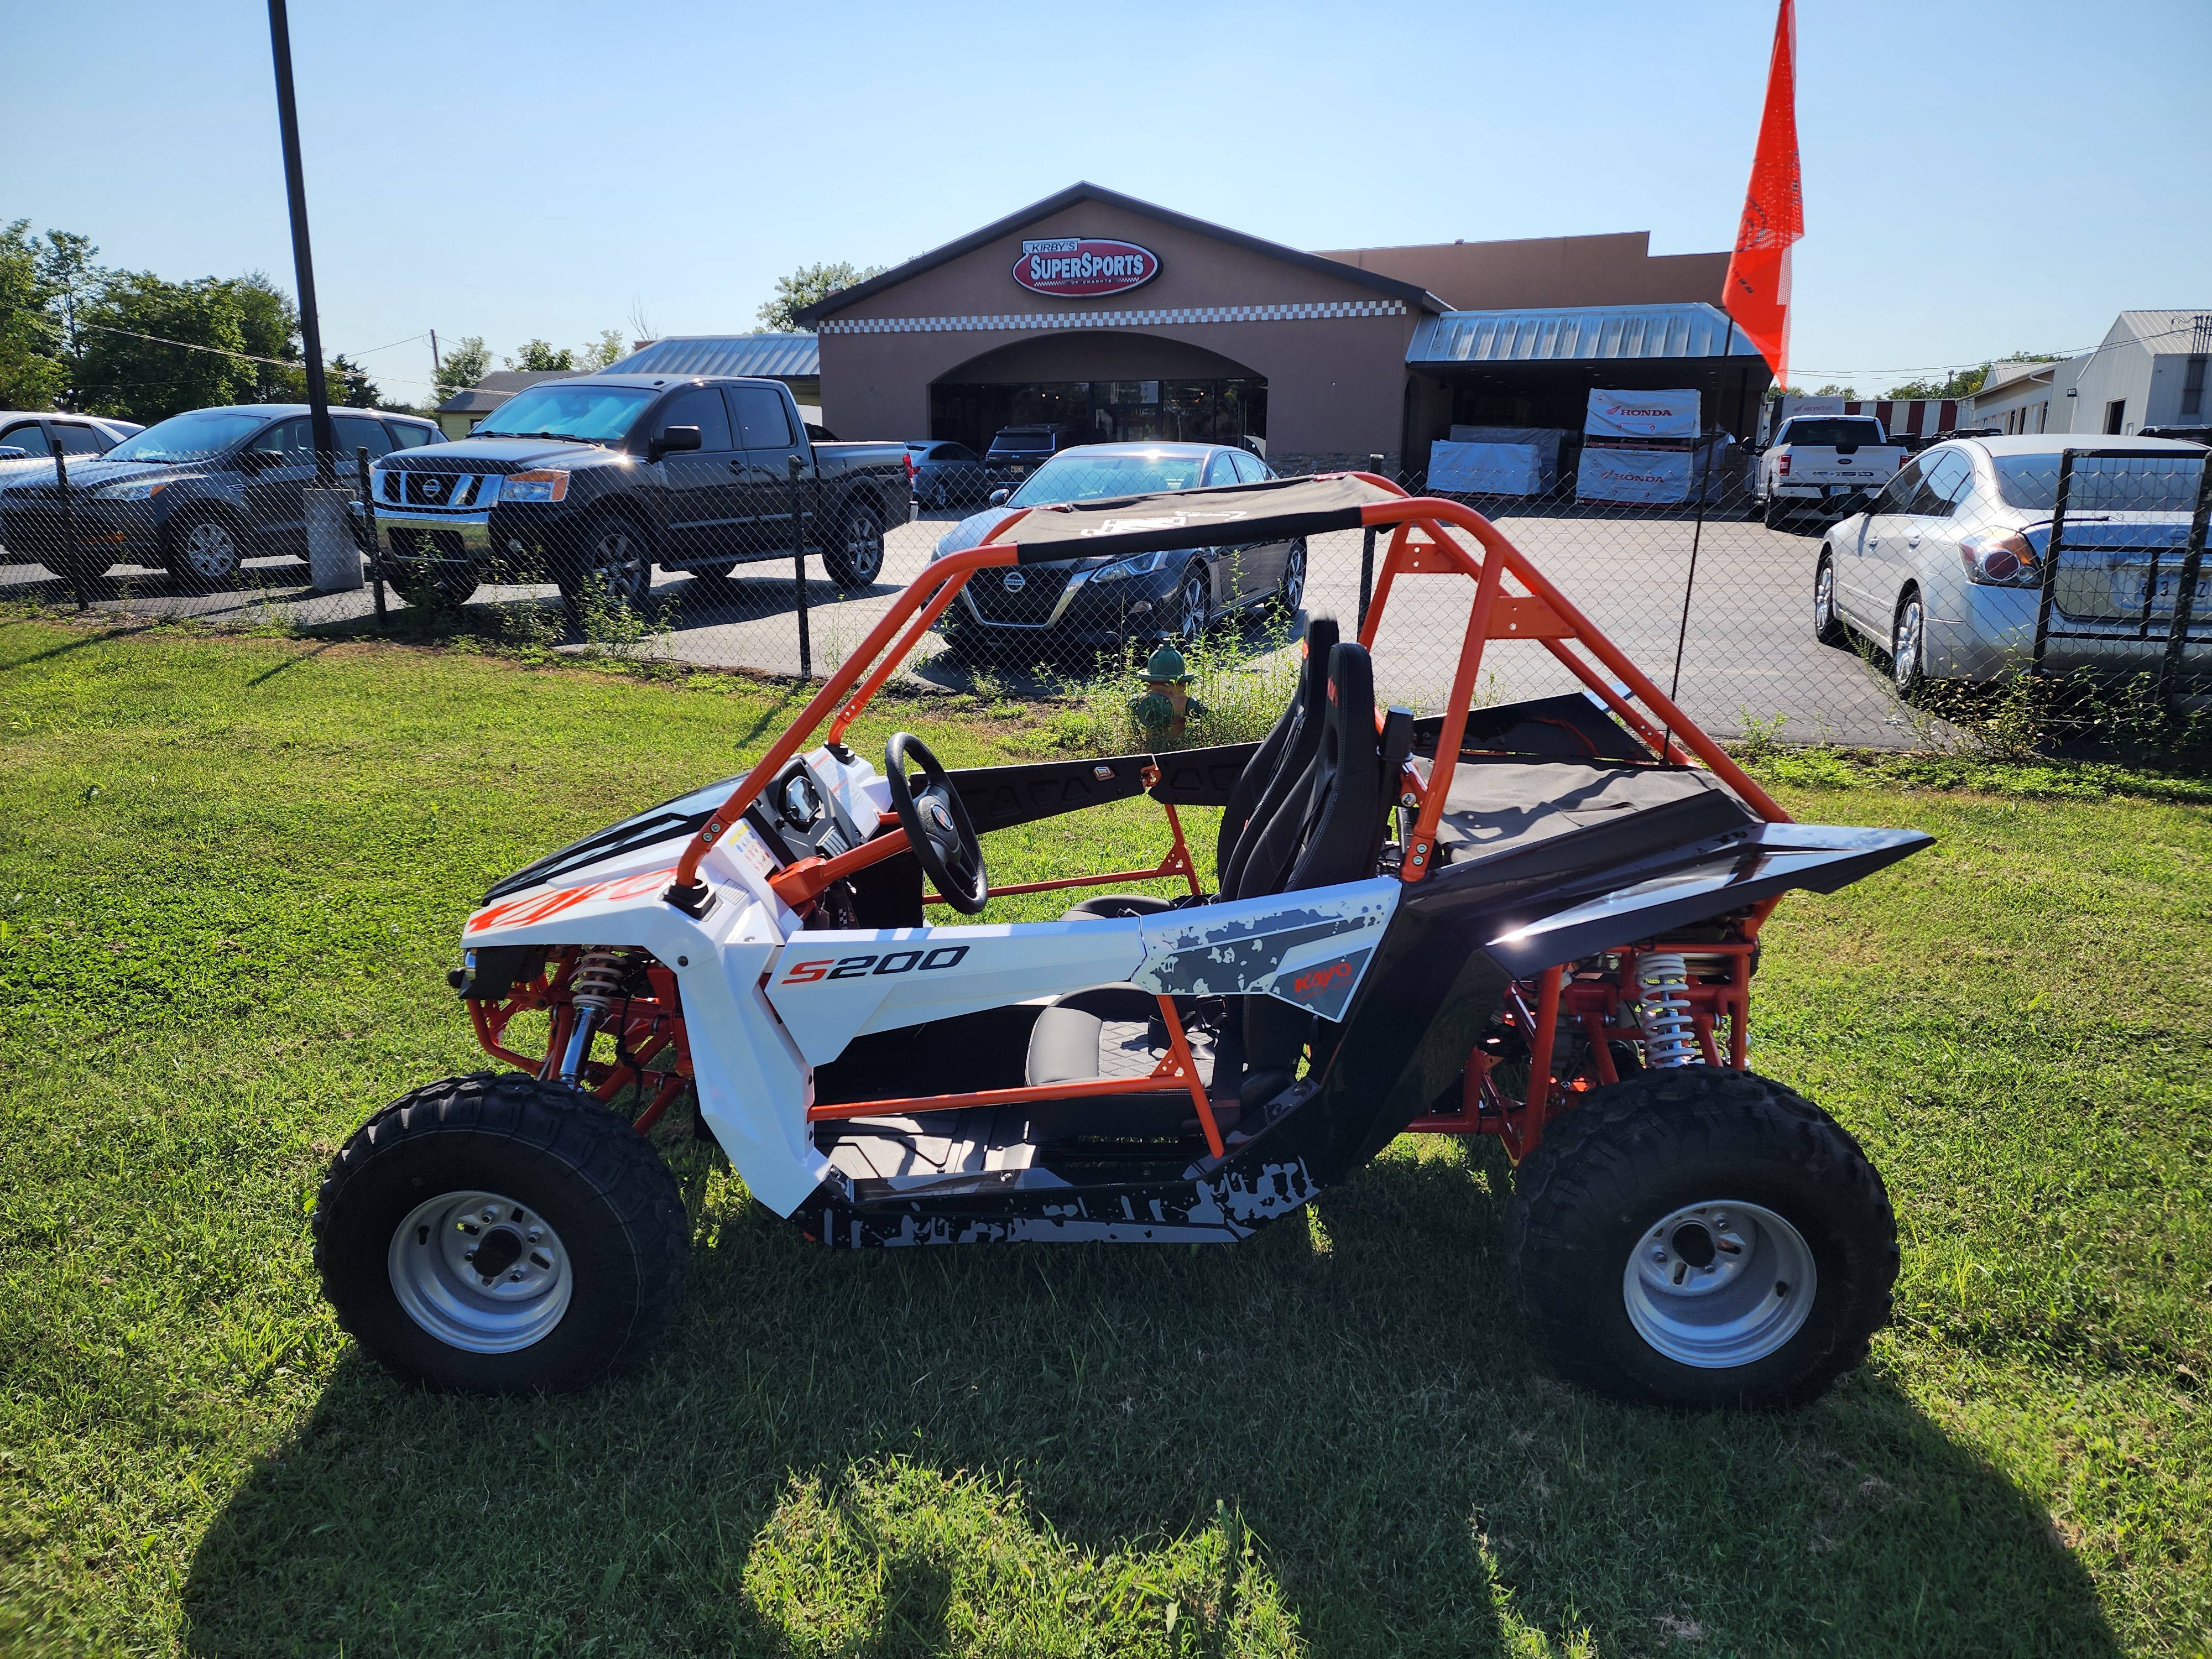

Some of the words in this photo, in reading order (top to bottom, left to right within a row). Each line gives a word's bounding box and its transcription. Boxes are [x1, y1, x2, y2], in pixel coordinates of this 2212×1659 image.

[1032, 242, 1076, 252] KIRBY'S
[1614, 473, 1665, 483] HONDA
[780, 946, 971, 985] S200
[1293, 962, 1353, 994] KAYO
